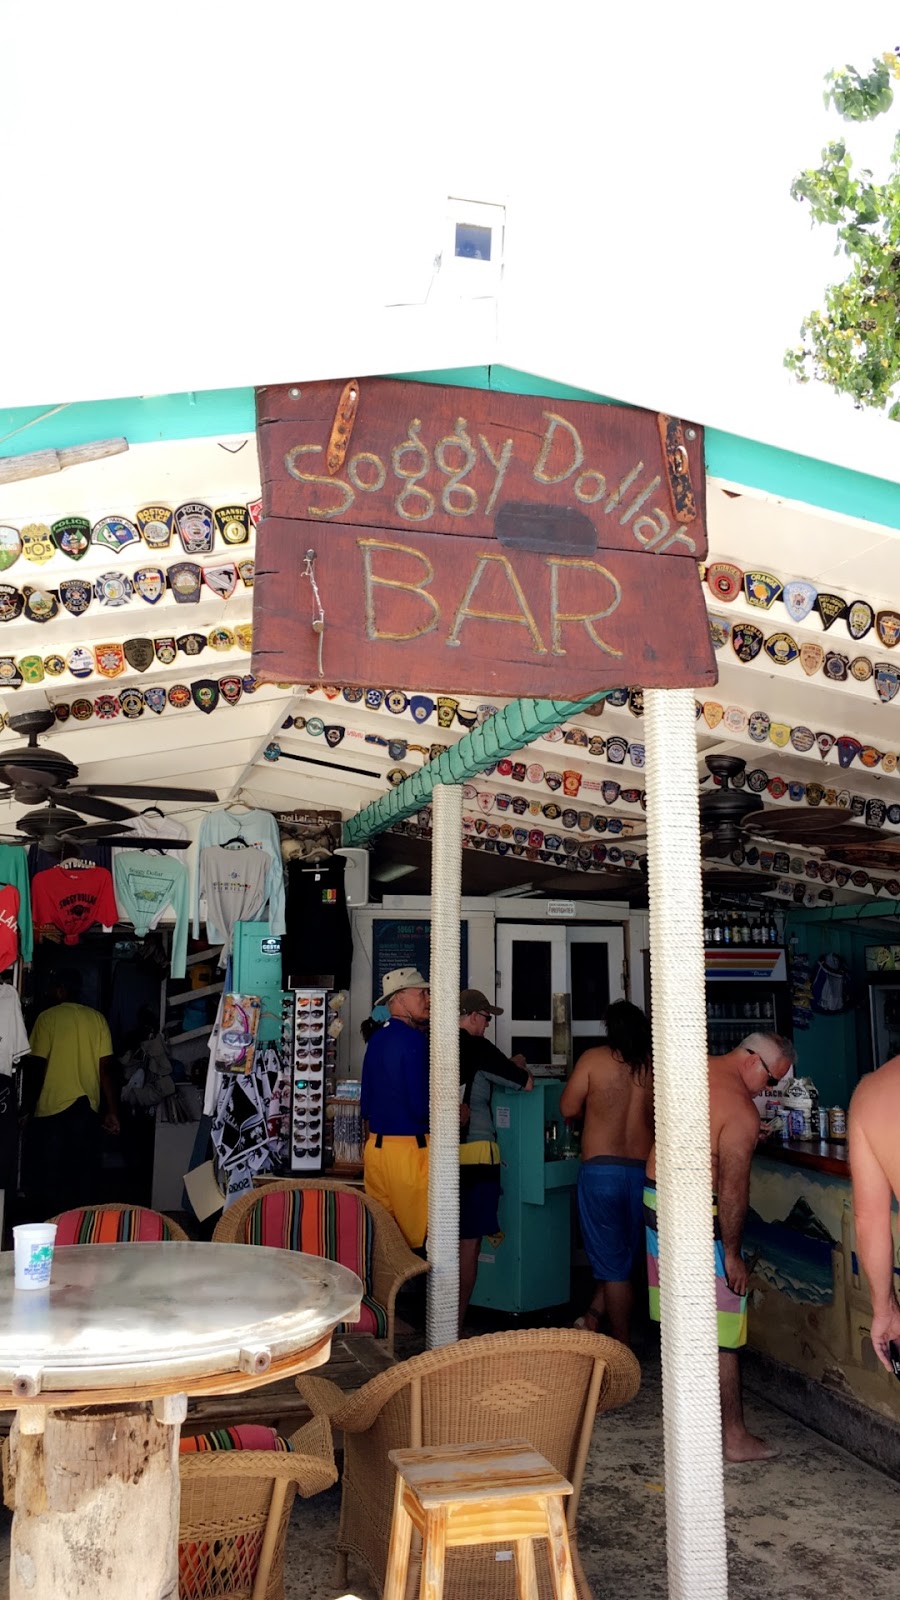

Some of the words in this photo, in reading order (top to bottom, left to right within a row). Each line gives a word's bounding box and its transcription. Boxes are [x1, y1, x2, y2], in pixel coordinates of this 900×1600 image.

[285, 417, 513, 521] Soggy
[533, 411, 696, 554] Dollar
[137, 508, 171, 519] BOSTON
[183, 505, 205, 513] POLICE
[216, 508, 246, 518] TRANSIT
[141, 514, 168, 524] POLICE
[222, 515, 245, 523] POLICE
[53, 518, 90, 531] POLICE
[715, 565, 738, 575] POLICE
[750, 574, 778, 589] ORANGE
[356, 537, 623, 658] BAR
